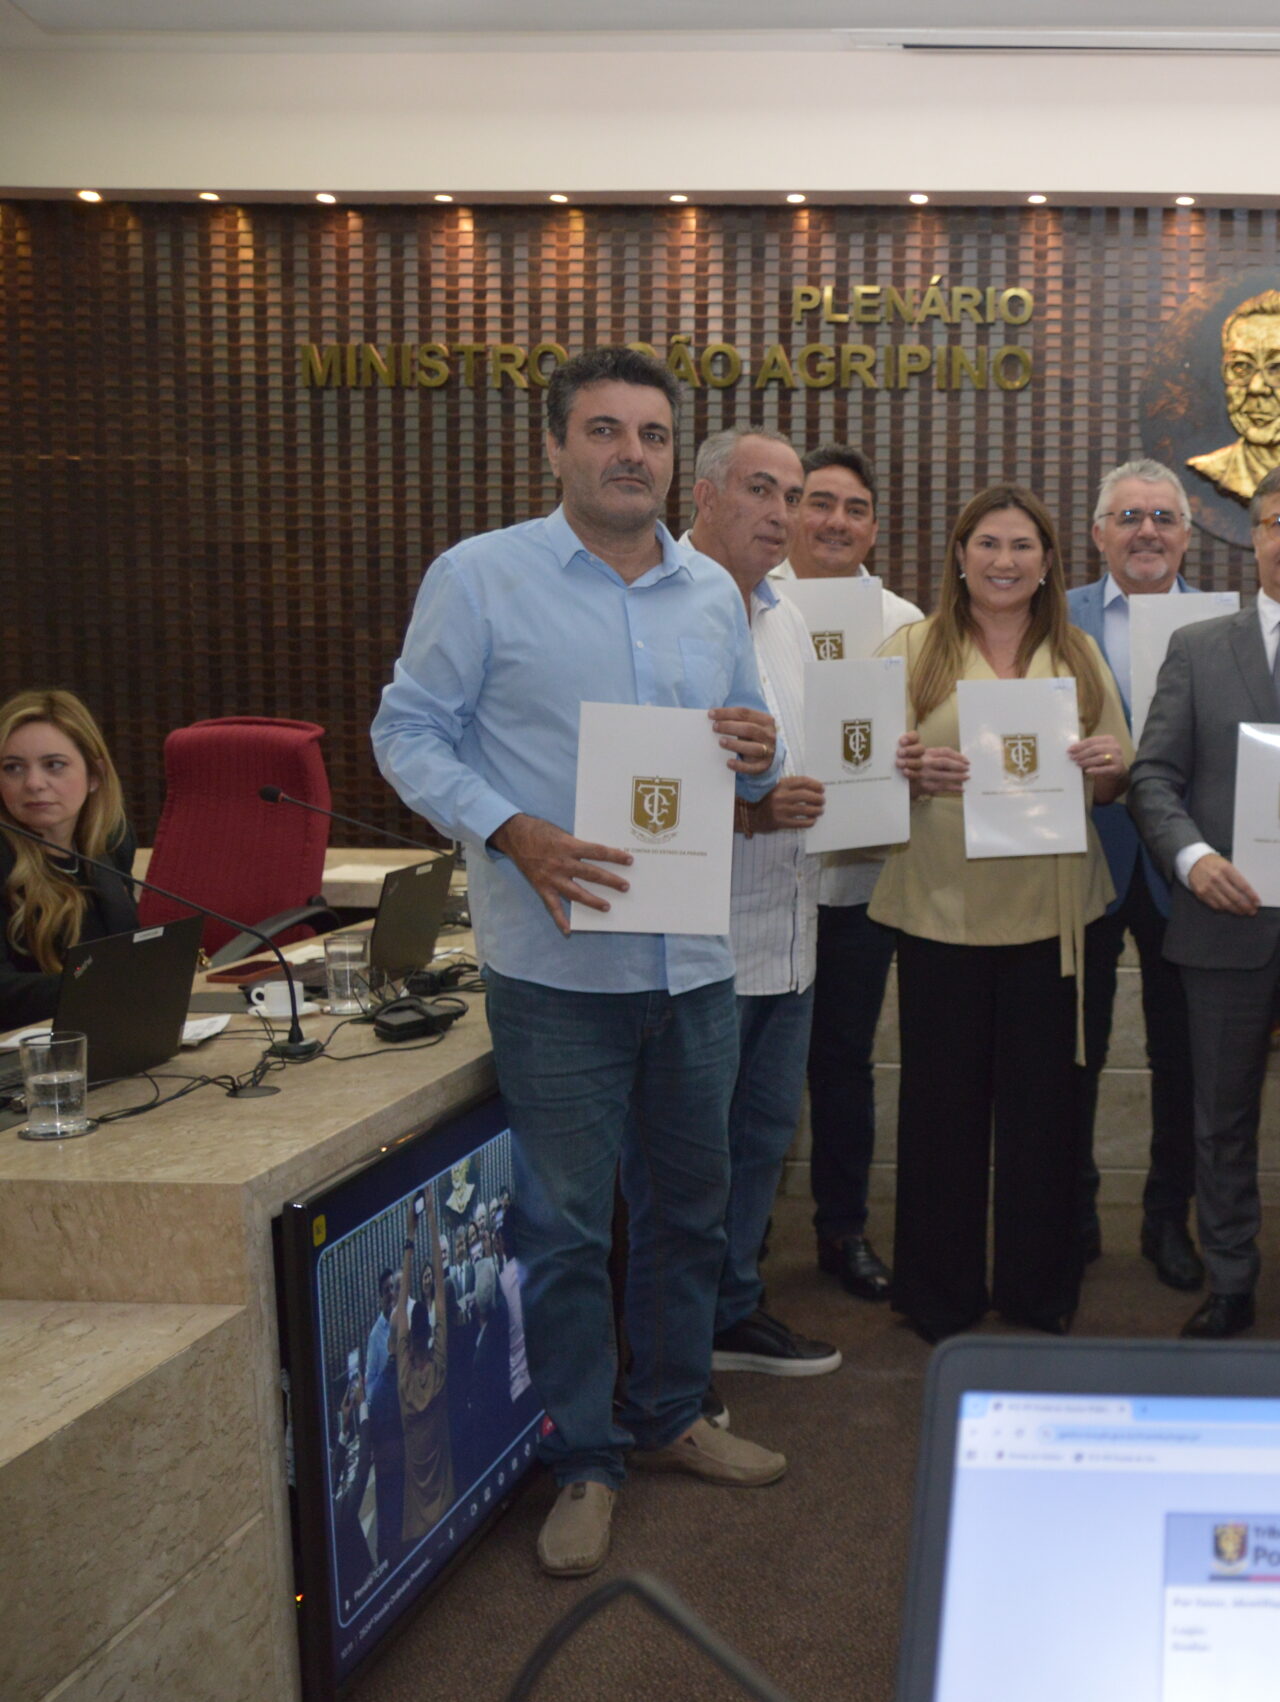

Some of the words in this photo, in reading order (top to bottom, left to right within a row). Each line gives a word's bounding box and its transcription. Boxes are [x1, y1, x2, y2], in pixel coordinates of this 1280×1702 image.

[792, 274, 1034, 325] PLENÁRIO
[300, 342, 569, 388] MINISTRO
[754, 342, 1033, 391] AGRIPINO
